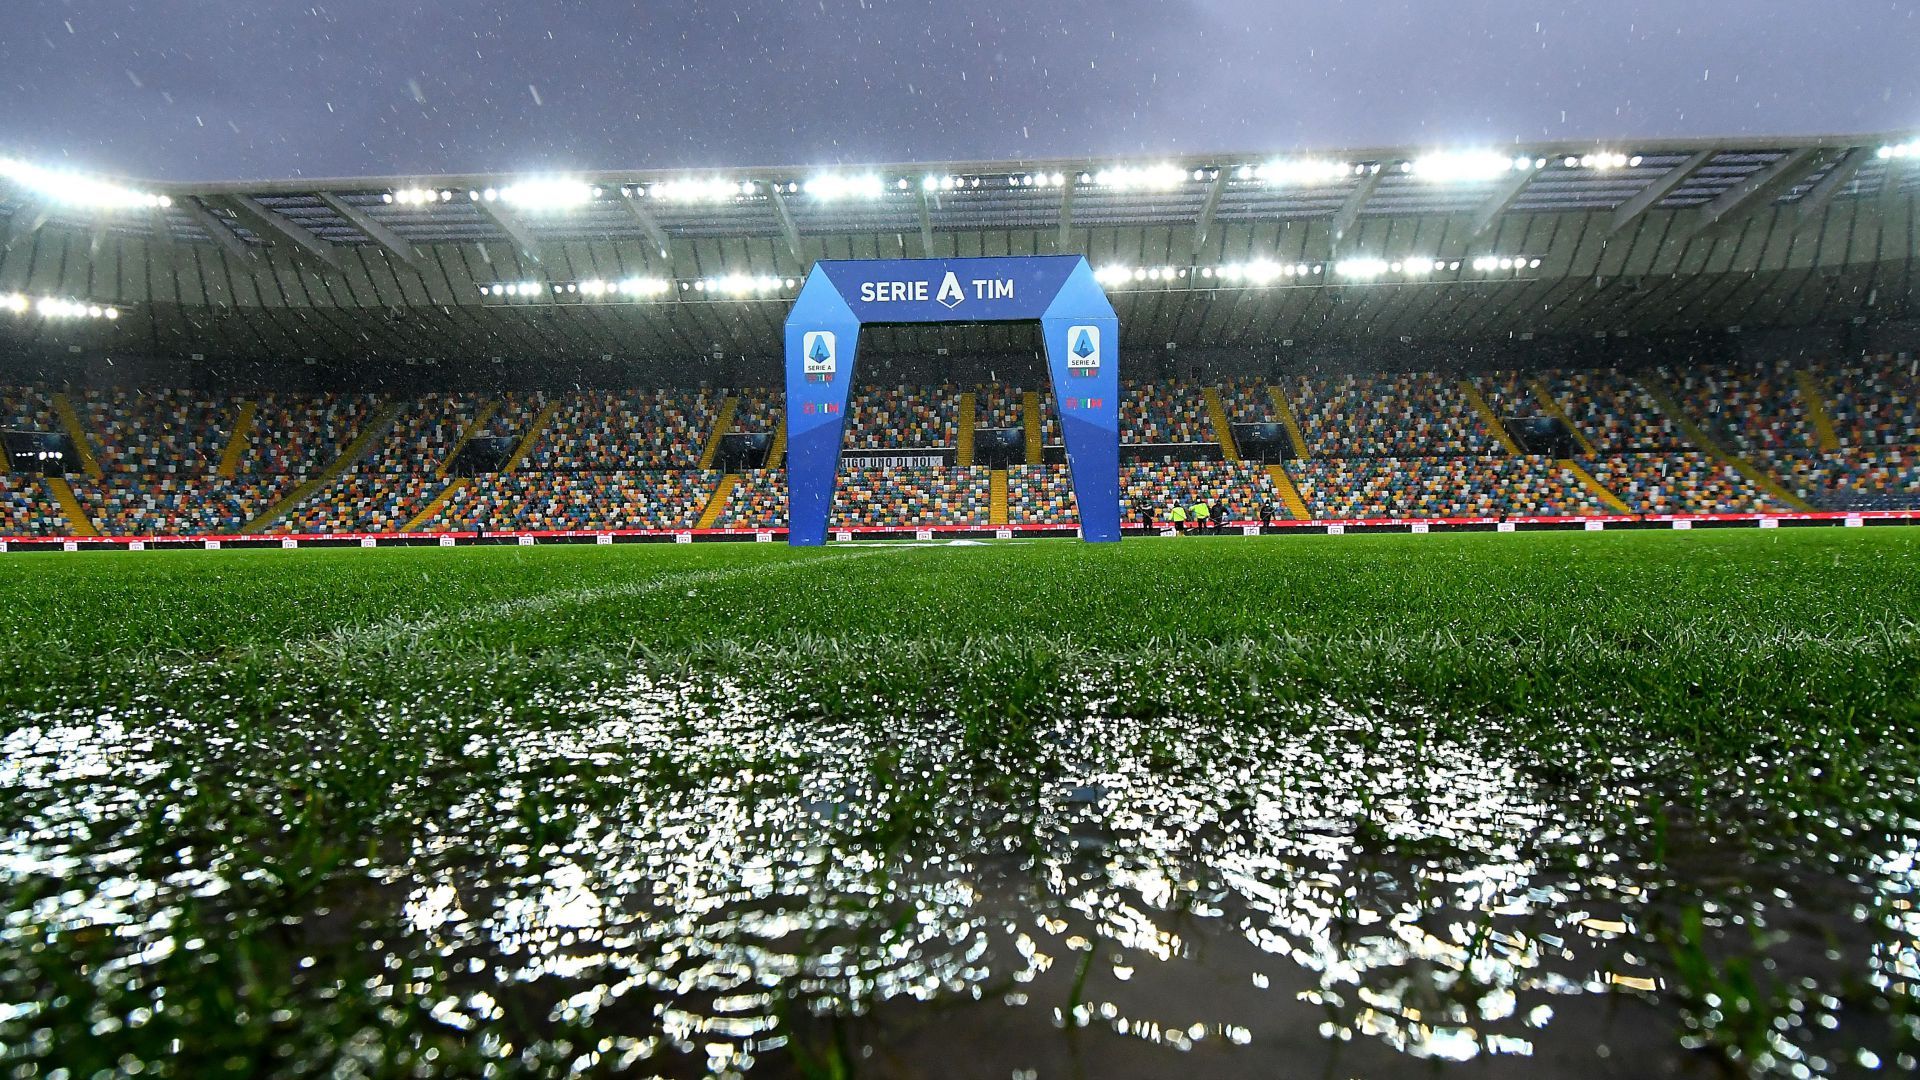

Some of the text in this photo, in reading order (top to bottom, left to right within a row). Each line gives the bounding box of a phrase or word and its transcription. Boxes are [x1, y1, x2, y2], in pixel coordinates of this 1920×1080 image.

[860, 272, 1014, 308] SERIE A TIM
[816, 403, 839, 414] TIM
[1080, 398, 1103, 409] TIM
[870, 458, 892, 468] UNO
[896, 457, 906, 467] DI
[912, 457, 931, 467] NOI
